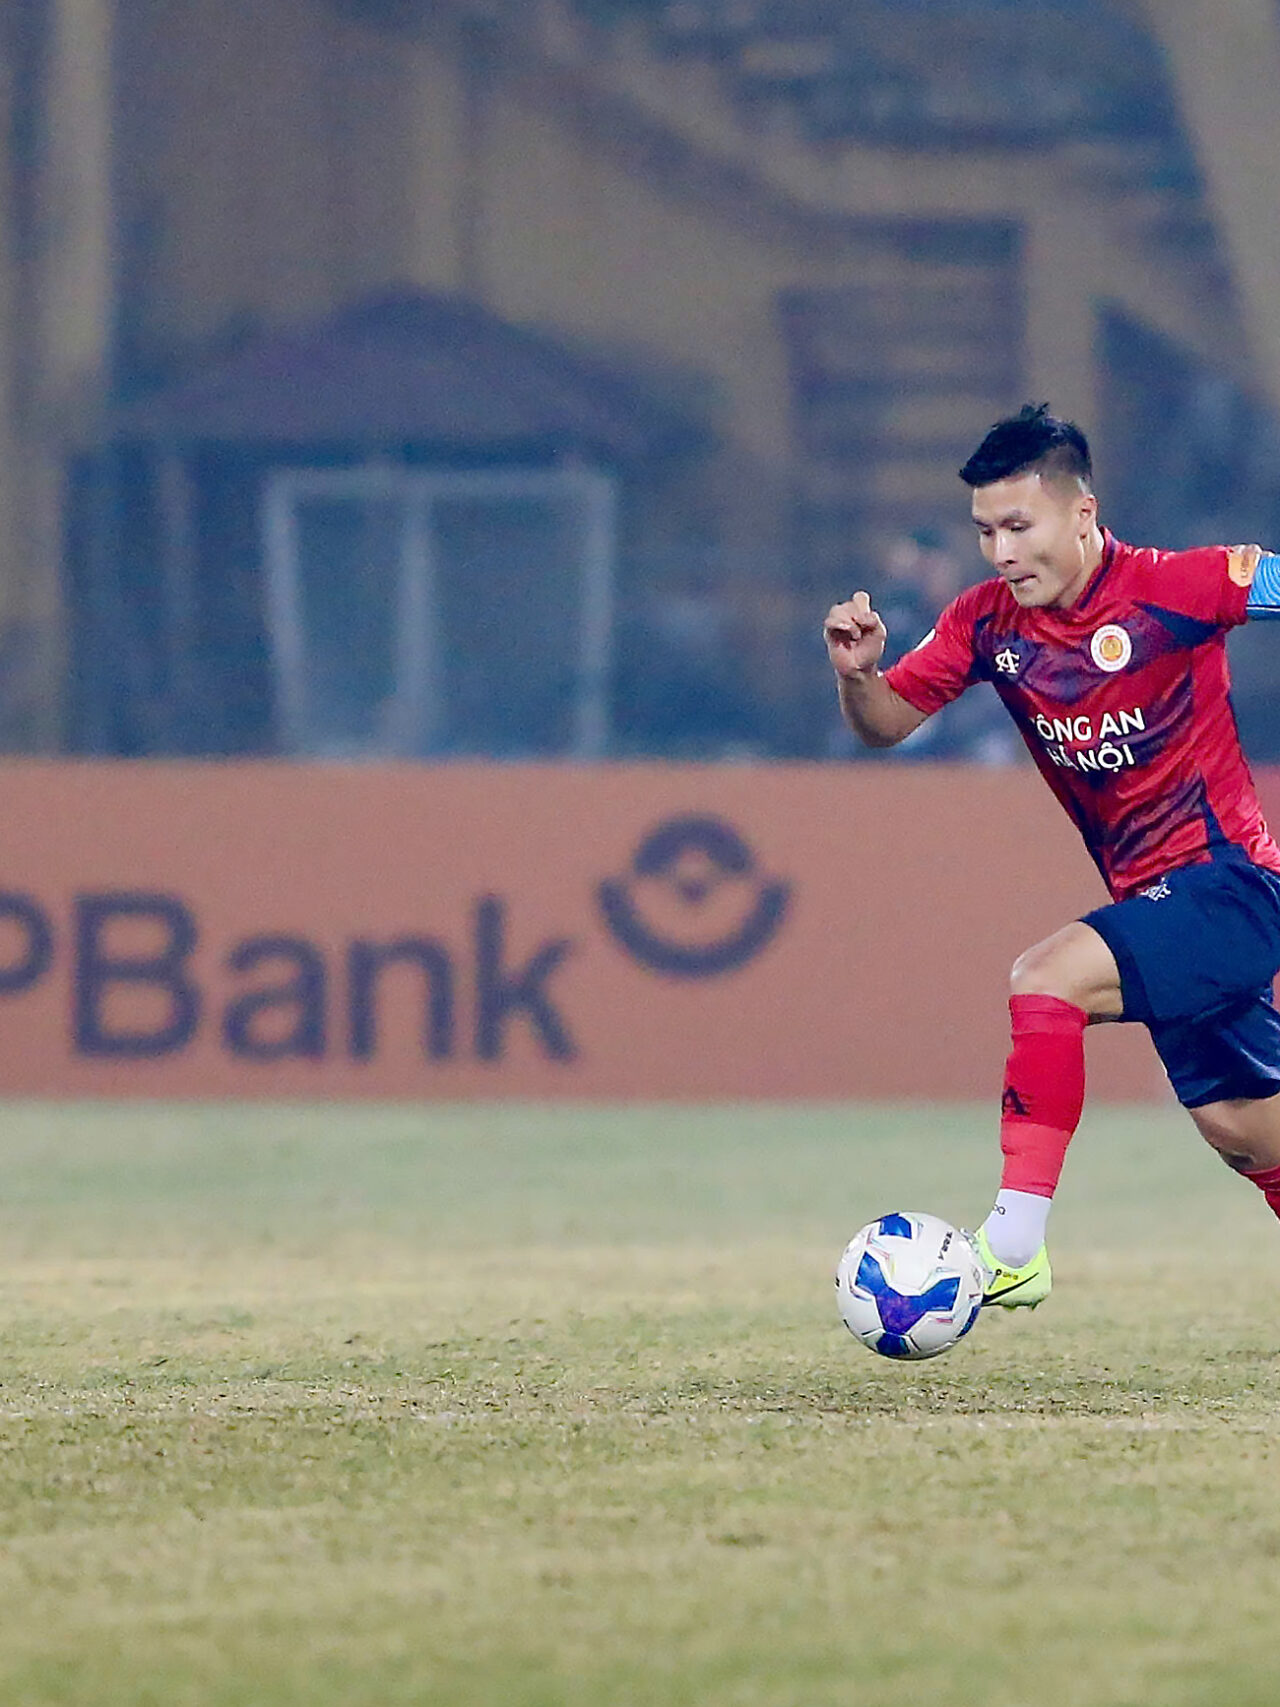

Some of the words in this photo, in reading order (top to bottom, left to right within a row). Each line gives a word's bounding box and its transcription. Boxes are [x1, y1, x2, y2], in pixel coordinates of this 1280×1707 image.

[1029, 713, 1092, 742] ÔNG
[1099, 707, 1145, 739] AN
[1076, 741, 1135, 773] NỘI
